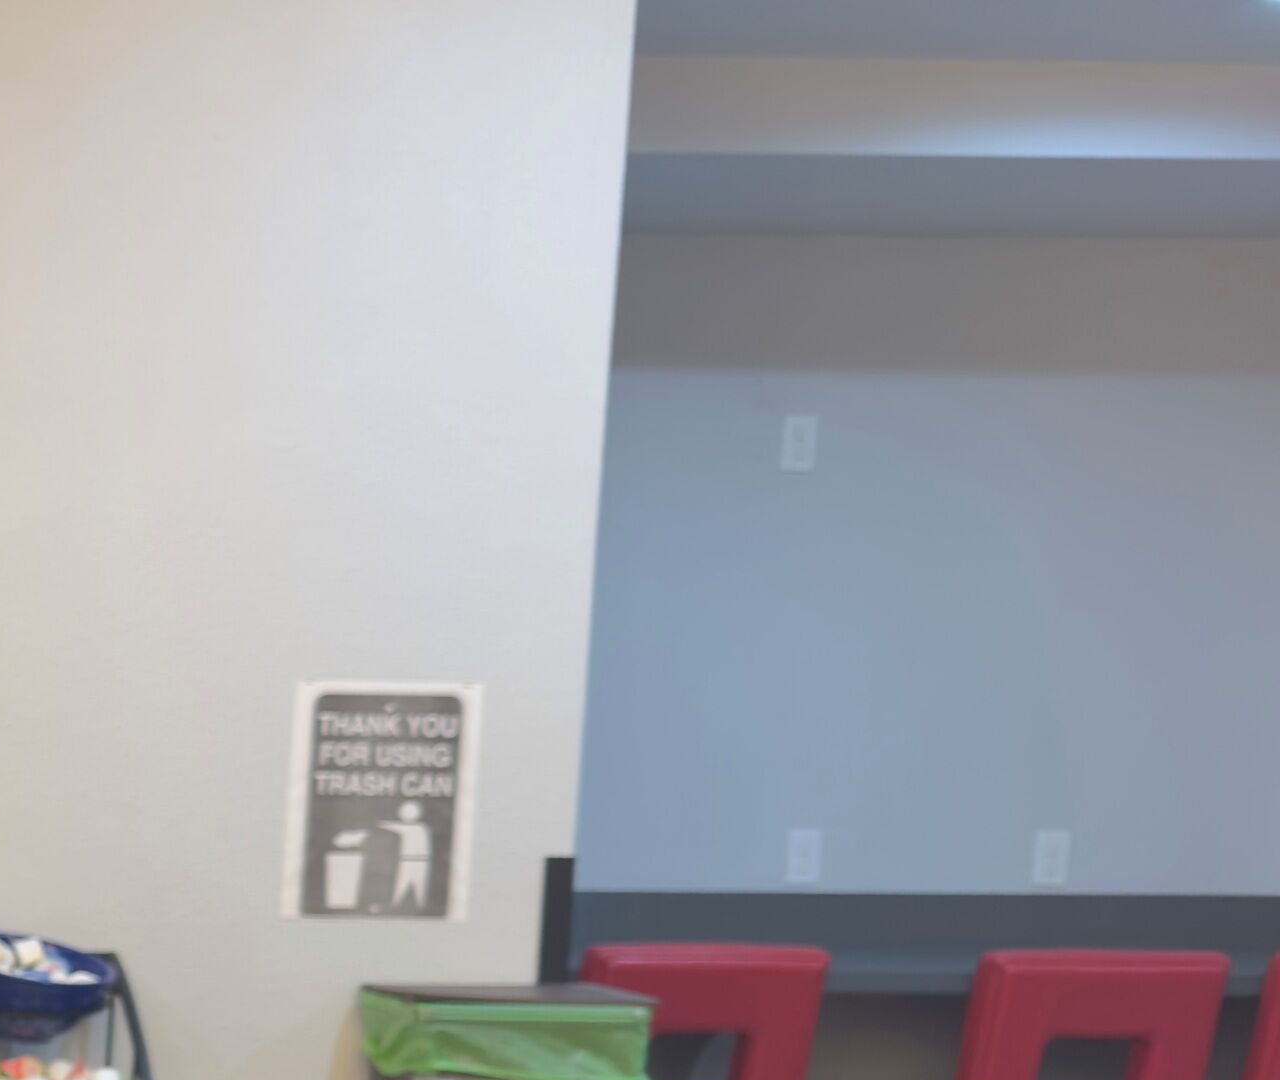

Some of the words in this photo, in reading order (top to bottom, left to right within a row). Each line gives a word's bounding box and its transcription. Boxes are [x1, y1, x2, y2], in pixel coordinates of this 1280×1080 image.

[317, 712, 402, 737] THANK
[406, 713, 460, 738] YOU
[318, 743, 370, 767] FOR
[375, 743, 451, 768] USING
[315, 771, 396, 796] TRASH
[400, 773, 454, 798] CAN
